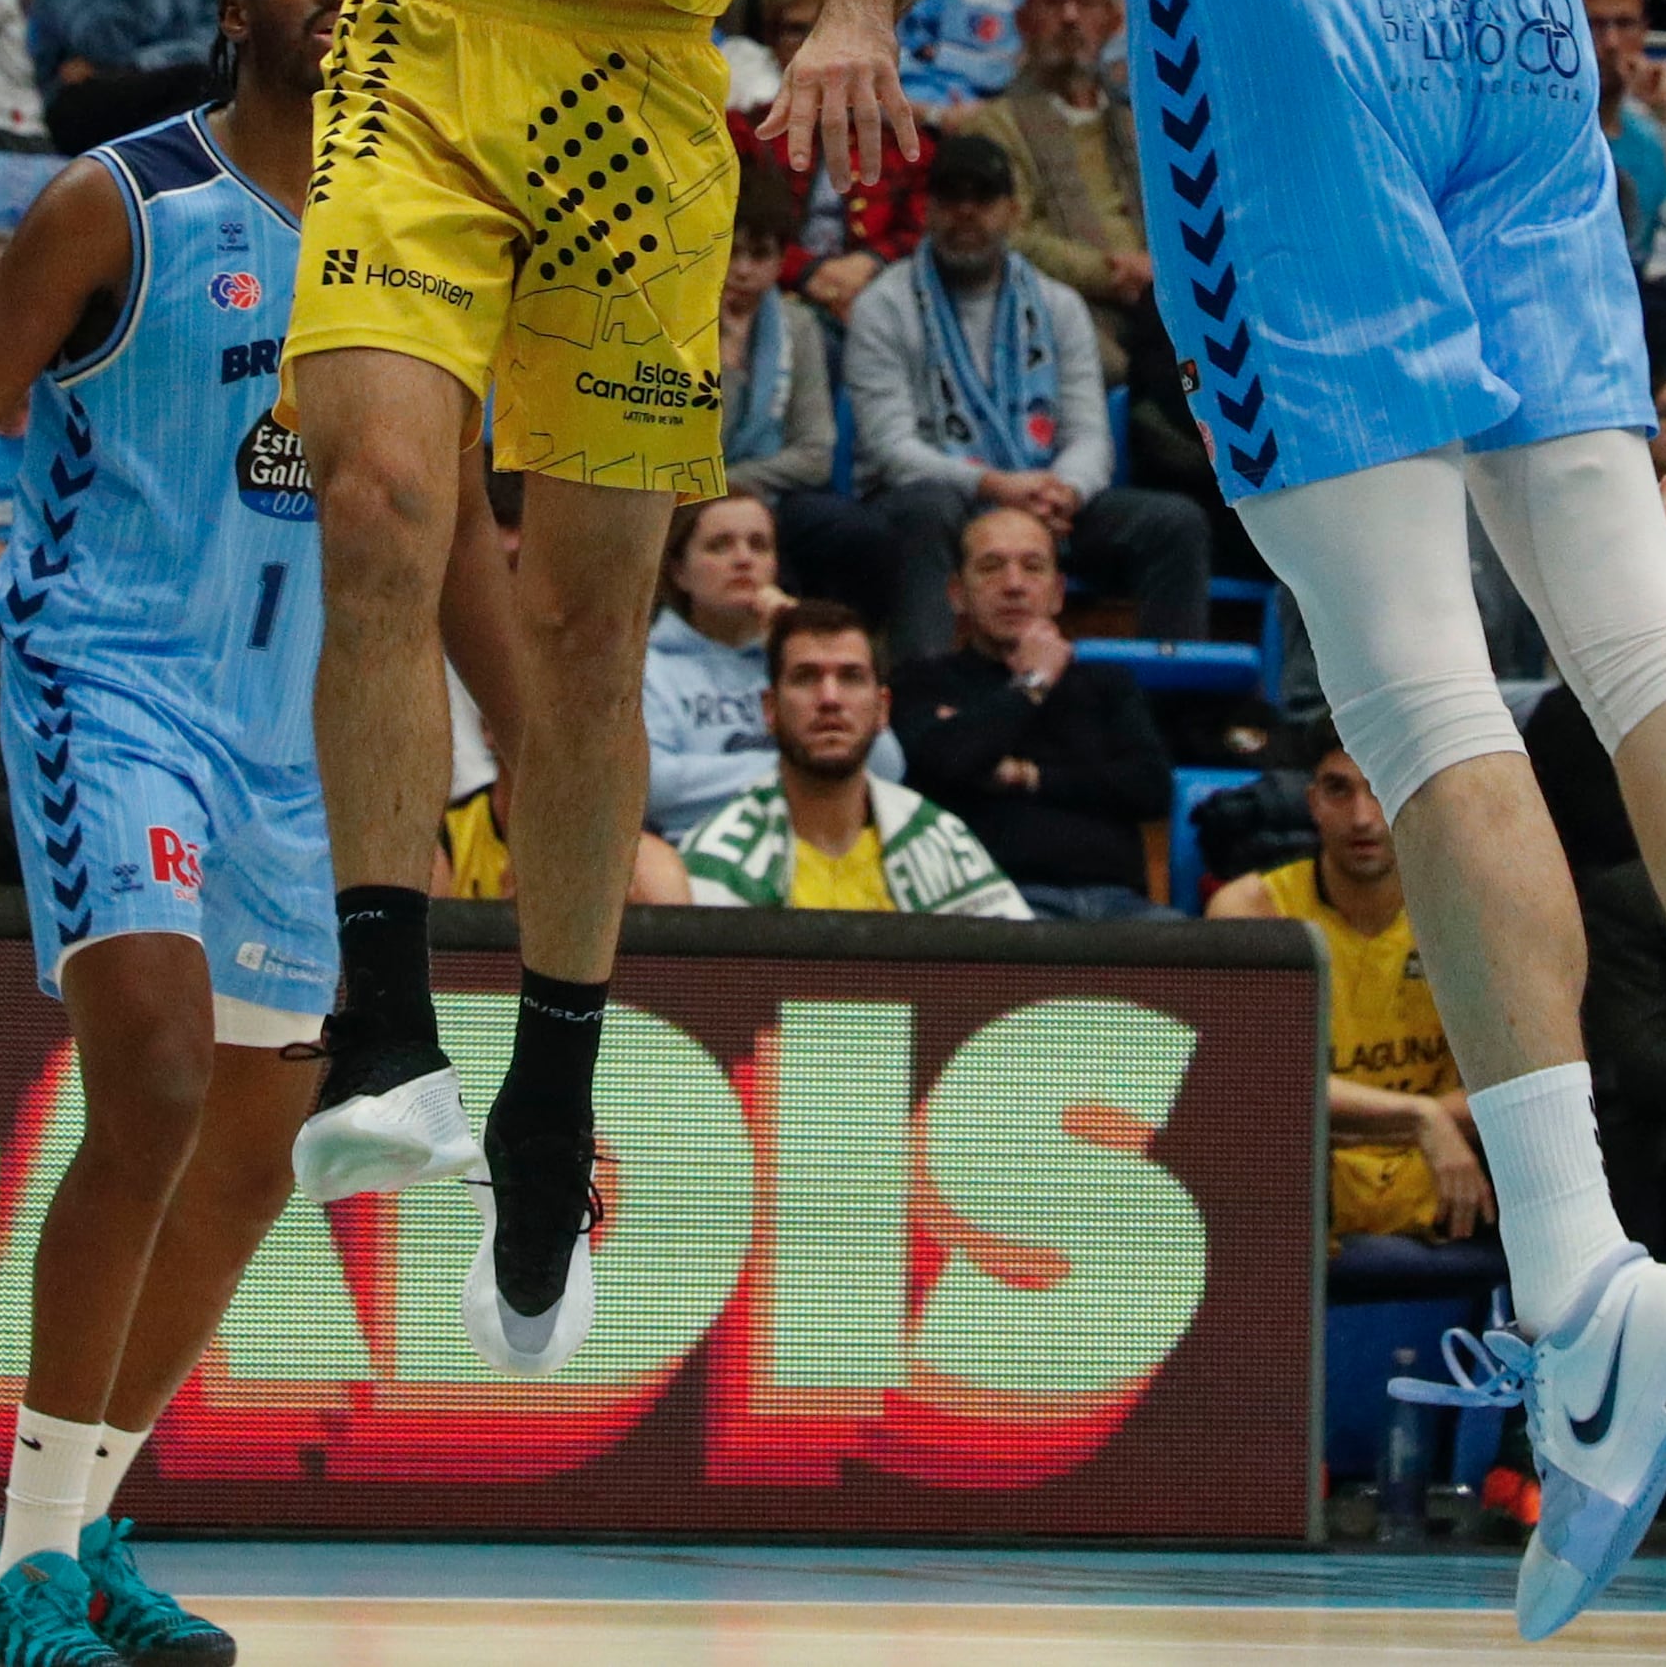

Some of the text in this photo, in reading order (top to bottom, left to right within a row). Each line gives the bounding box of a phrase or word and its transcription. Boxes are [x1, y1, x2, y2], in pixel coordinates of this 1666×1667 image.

[1423, 21, 1506, 65] LUO
[365, 262, 474, 311] Hospiten
[576, 371, 689, 408] Canarias
[635, 360, 692, 389] Islas
[247, 562, 287, 652] 1
